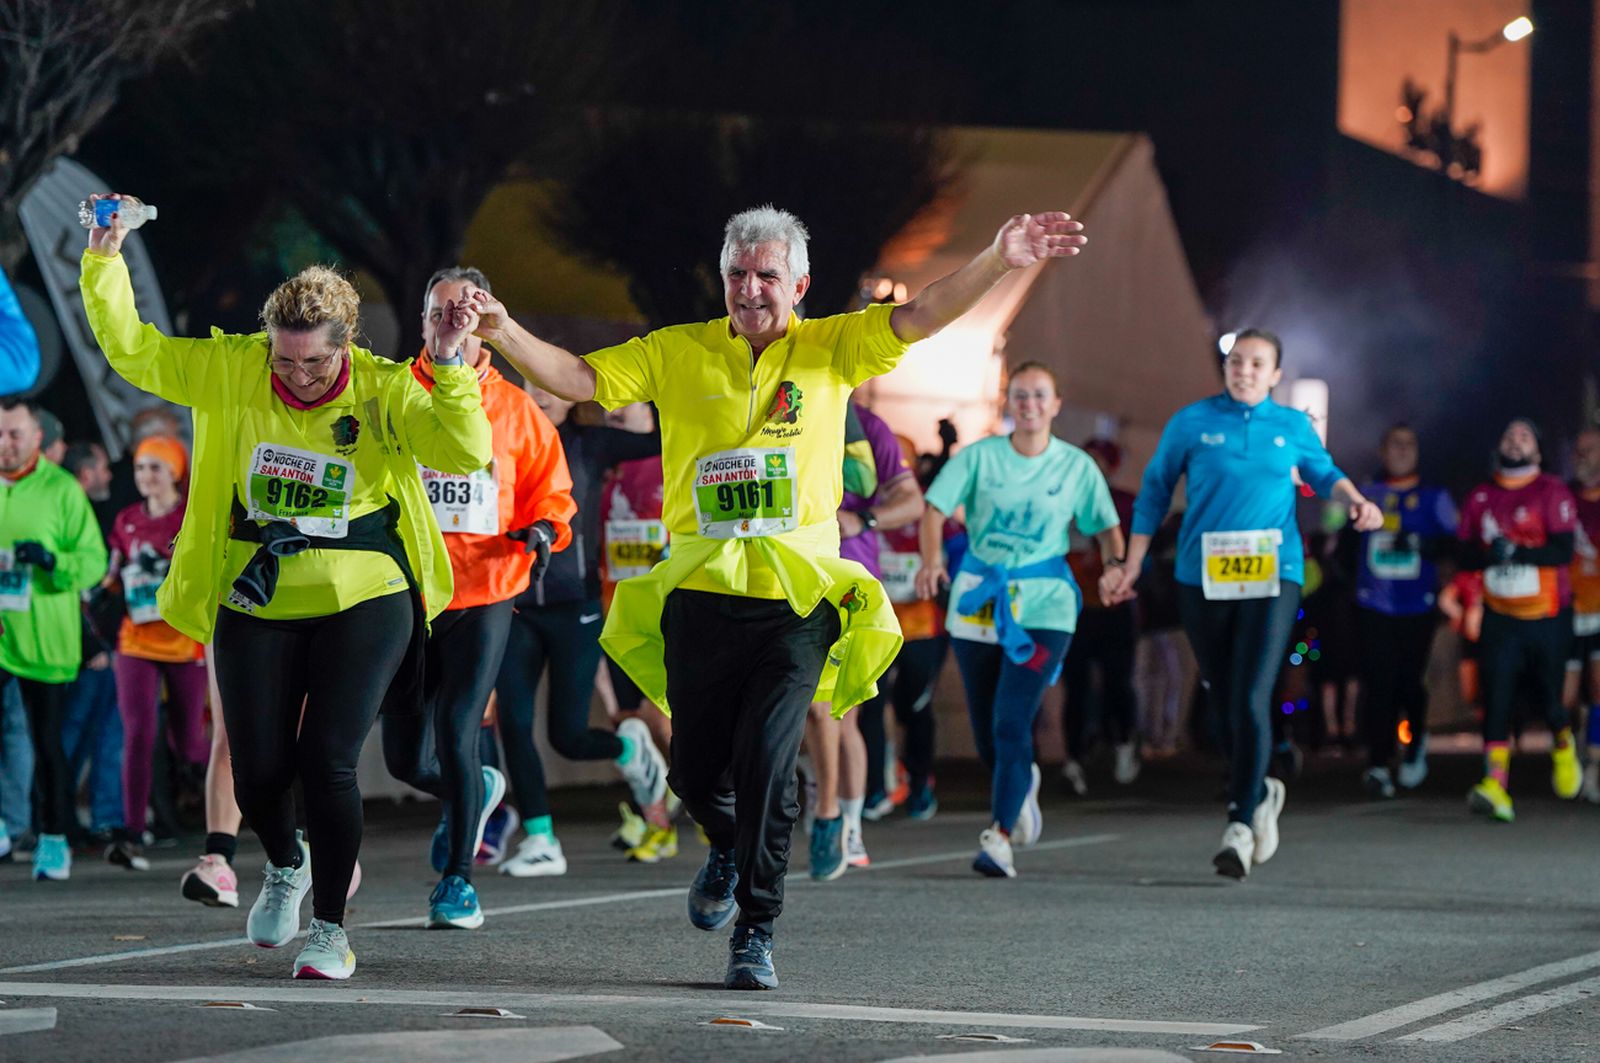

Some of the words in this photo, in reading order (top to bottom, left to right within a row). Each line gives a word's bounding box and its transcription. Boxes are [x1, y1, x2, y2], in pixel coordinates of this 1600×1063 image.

[260, 464, 281, 476] SAN
[273, 455, 303, 469] NOCHE
[303, 462, 317, 473] DE
[712, 460, 743, 472] NOCHE
[744, 458, 756, 468] DE
[702, 473, 722, 485] SAN
[724, 467, 757, 482] ANTÓN
[266, 477, 329, 509] 9162
[428, 480, 484, 506] 3634
[716, 480, 773, 512] 9161
[1220, 555, 1264, 576] 2427
